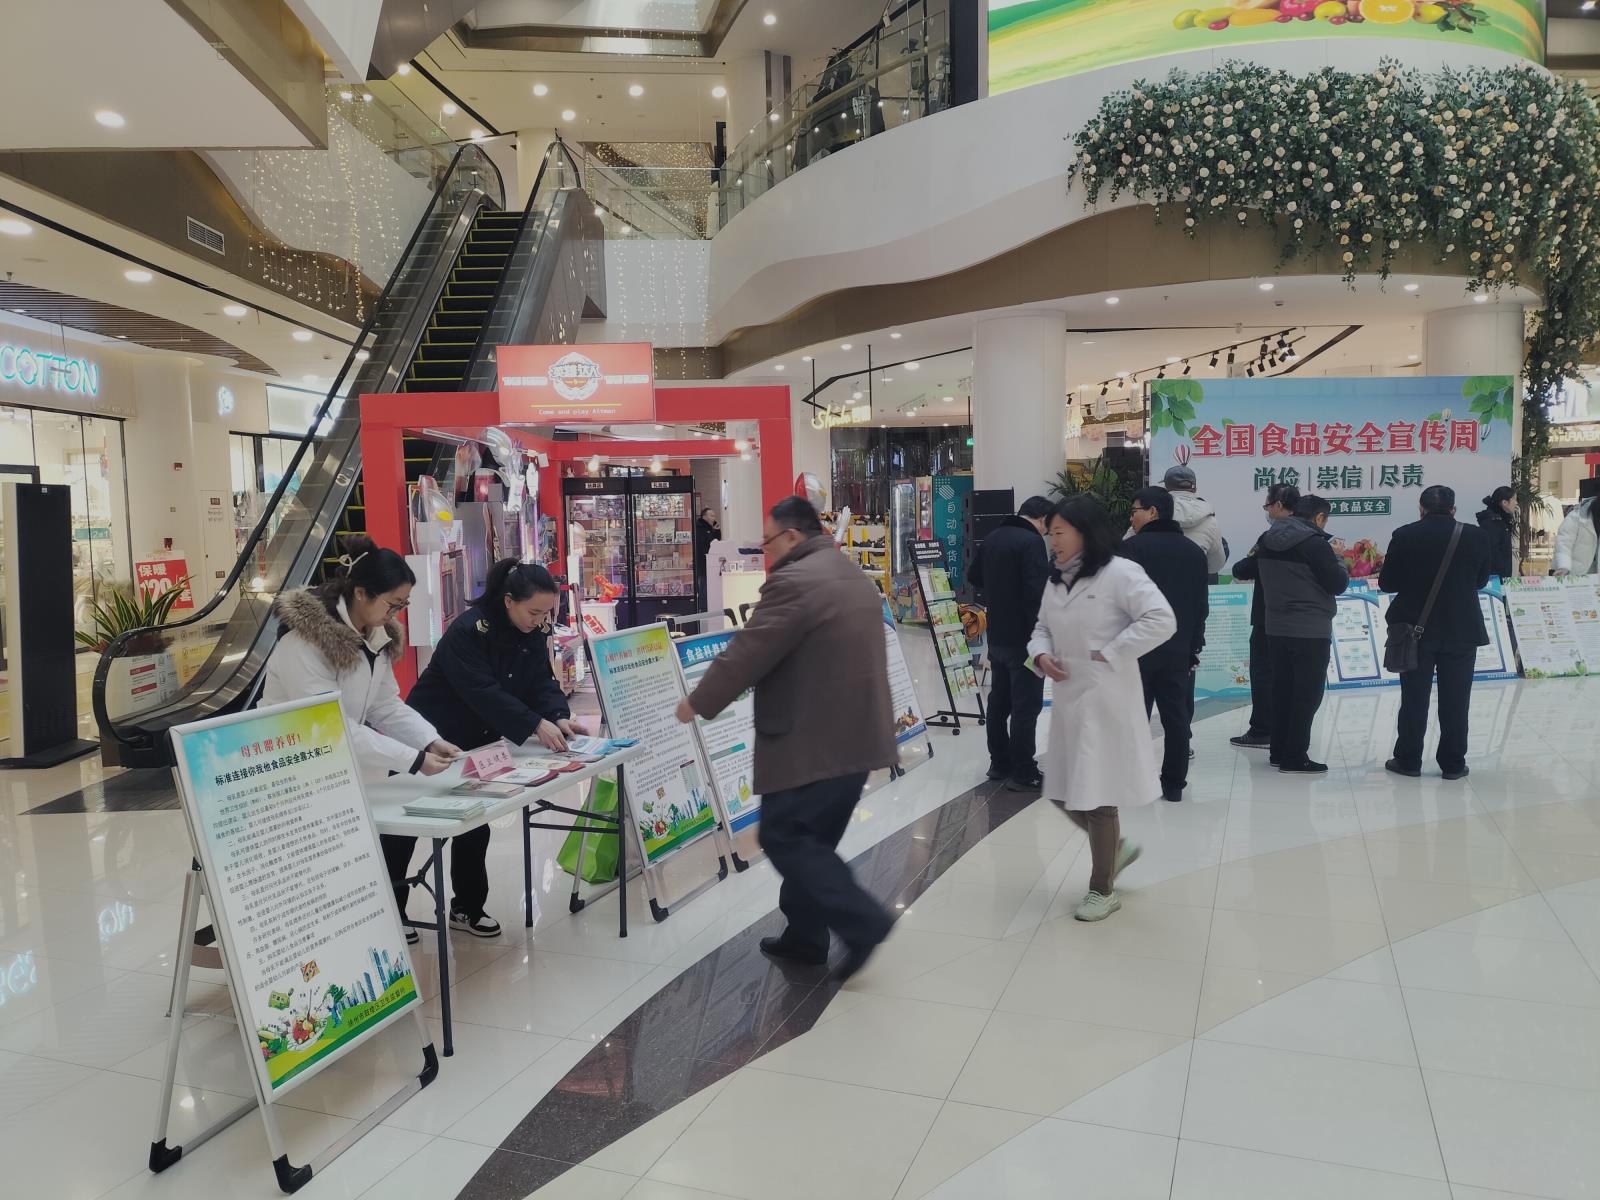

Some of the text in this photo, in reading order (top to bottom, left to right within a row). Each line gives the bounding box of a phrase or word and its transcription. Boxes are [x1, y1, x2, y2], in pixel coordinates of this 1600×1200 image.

[0, 344, 99, 396] COTTON
[1190, 419, 1479, 458] 全国食品安全宣传周
[1316, 465, 1363, 489] 崇信
[1378, 464, 1424, 488] 尽责
[946, 501, 959, 579] 自动售货机
[138, 563, 168, 577] 保暖
[214, 745, 333, 787] 标准连接你我他食品安全靠大家(二)
